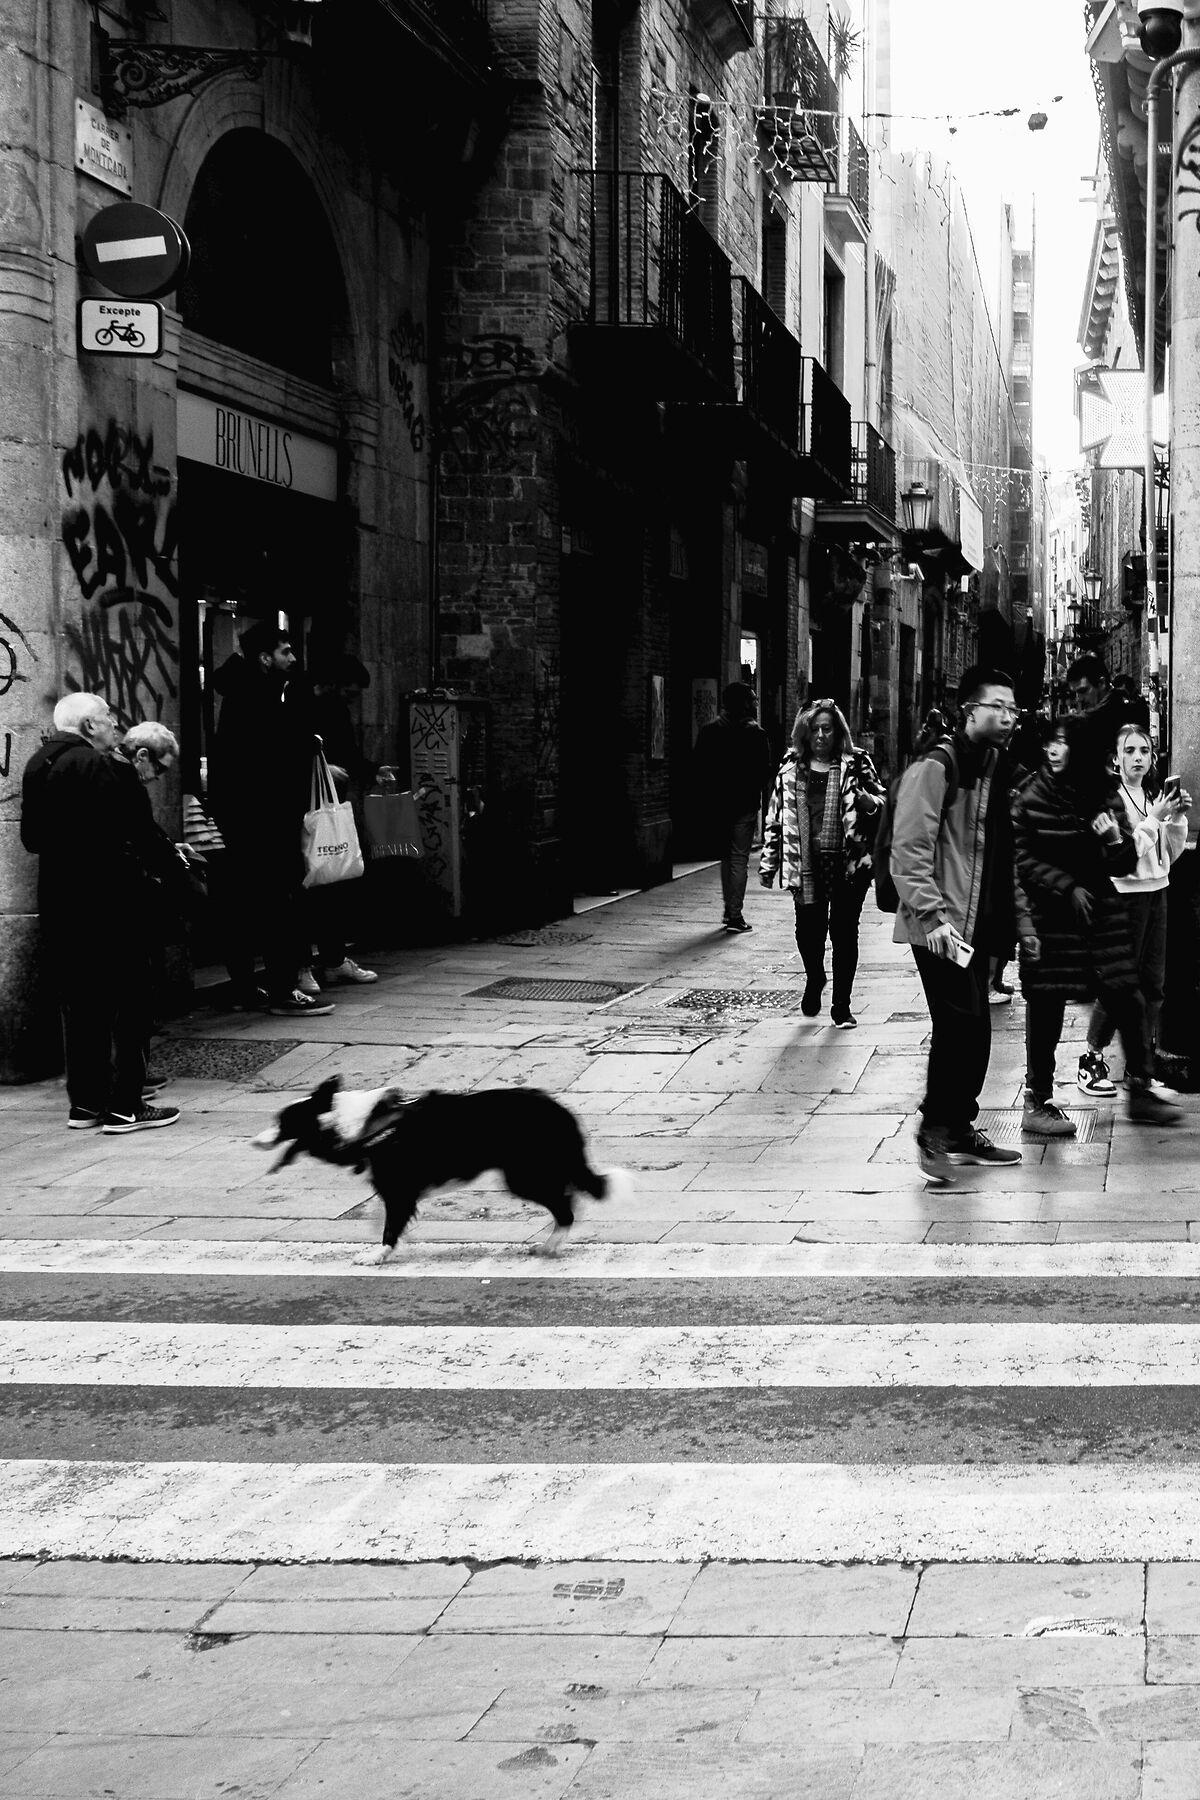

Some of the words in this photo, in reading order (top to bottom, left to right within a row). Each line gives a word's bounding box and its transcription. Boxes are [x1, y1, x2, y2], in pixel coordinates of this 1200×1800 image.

[91, 118, 119, 143] CARRER
[101, 138, 111, 152] DE
[84, 143, 127, 181] MONTCADA
[100, 305, 141, 317] Excepte
[216, 407, 292, 488] BRUNELLS
[317, 841, 349, 853] TECHNO
